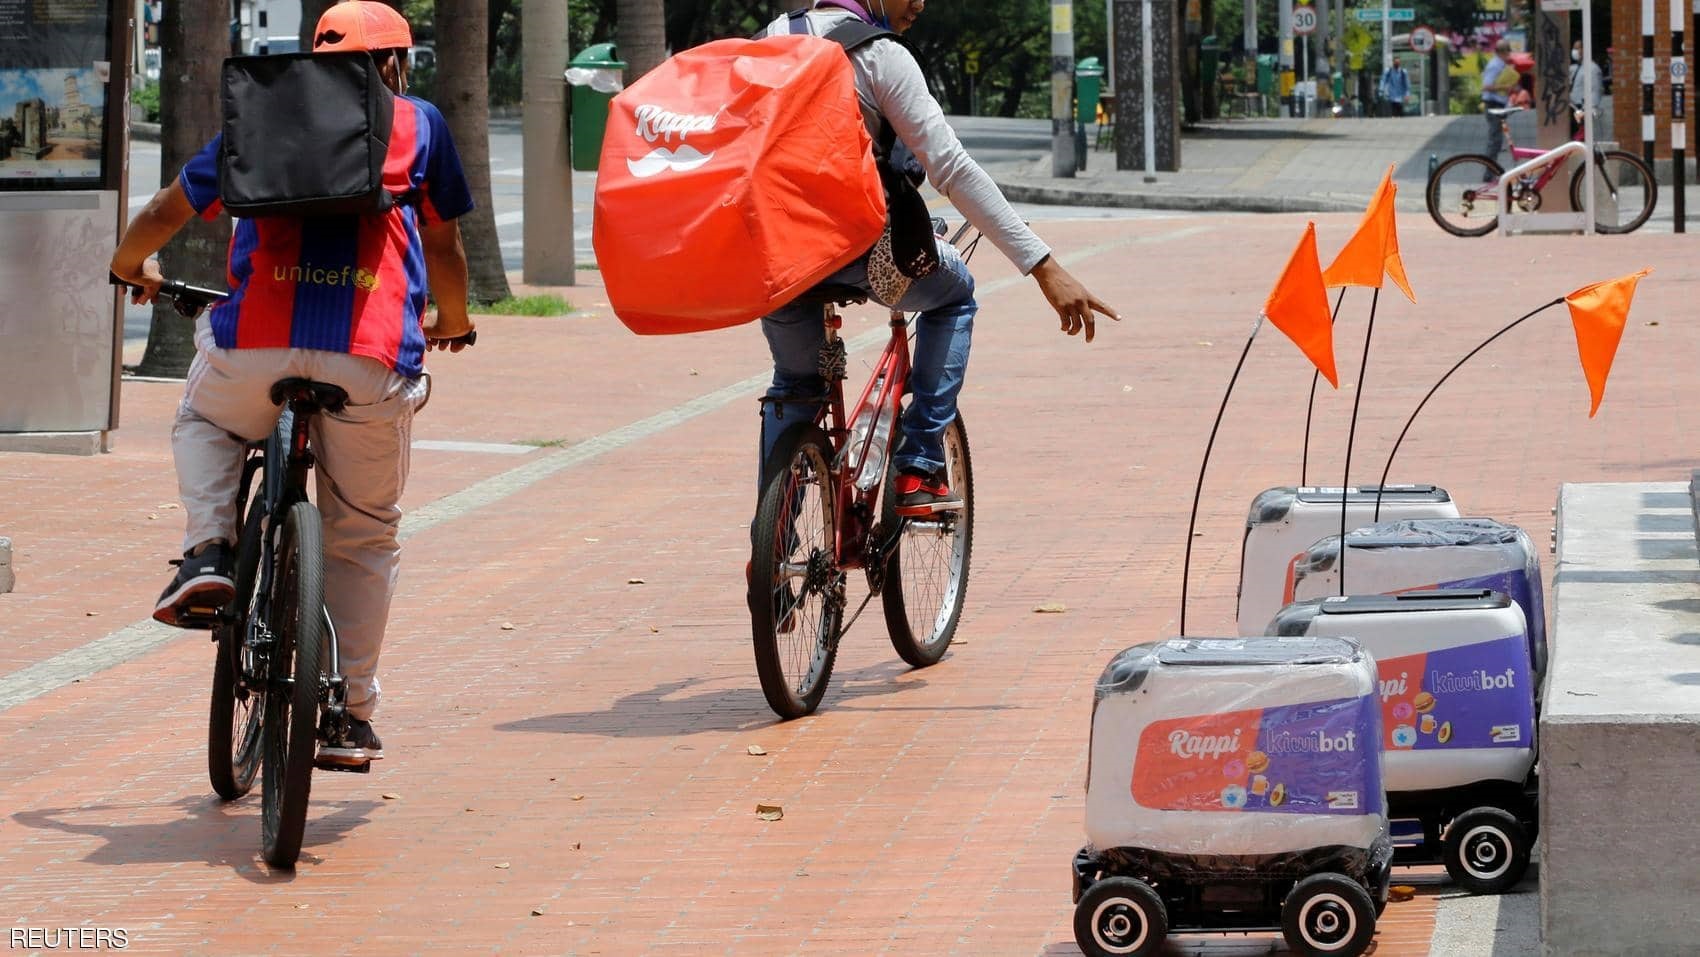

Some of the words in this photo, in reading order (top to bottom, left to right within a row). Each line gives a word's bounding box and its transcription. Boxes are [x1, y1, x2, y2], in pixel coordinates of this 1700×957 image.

[1295, 12, 1313, 27] 30
[634, 103, 727, 143] Rappi
[273, 262, 351, 287] unicef
[1431, 668, 1515, 694] kiwibot
[1168, 728, 1241, 760] Rappi
[1265, 728, 1356, 753] kiwibot
